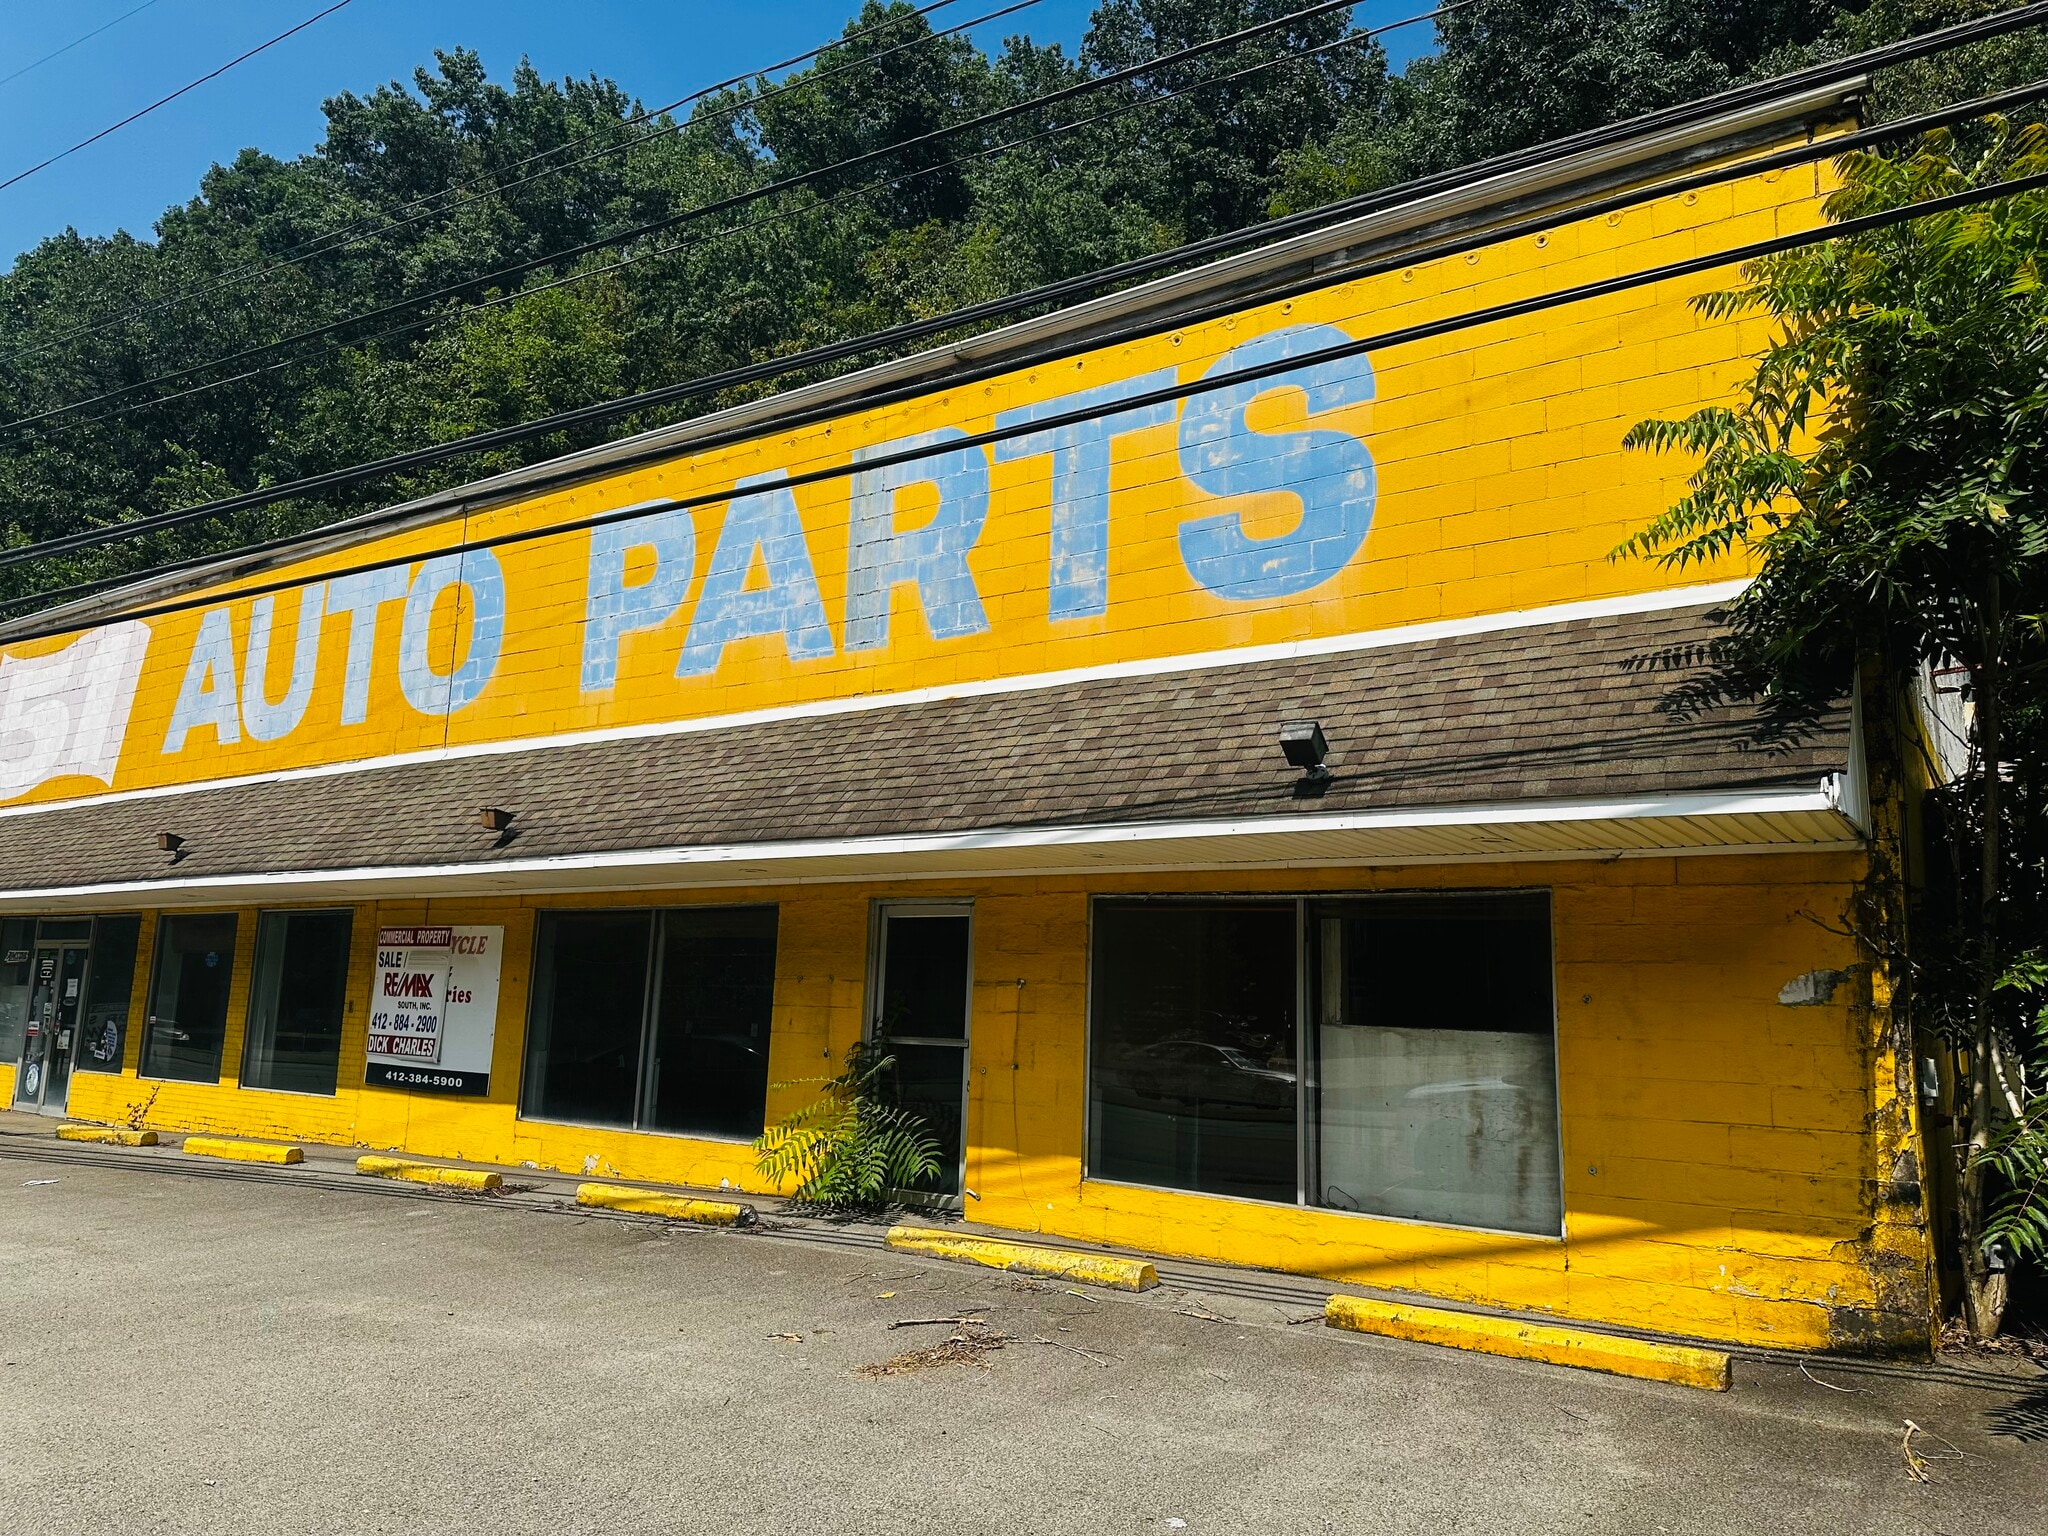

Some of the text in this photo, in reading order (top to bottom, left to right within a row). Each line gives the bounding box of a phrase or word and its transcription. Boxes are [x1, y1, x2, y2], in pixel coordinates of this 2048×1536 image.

[0, 323, 1377, 787] 51 AUTO PARTS
[379, 930, 450, 944] COMMERCIAL PROPERTY
[383, 971, 434, 998] RE/MAX
[397, 1001, 432, 1011] SOUTH, INC.
[368, 1035, 434, 1056] DICK CHARLES
[385, 1070, 463, 1088] 412-384-5900
